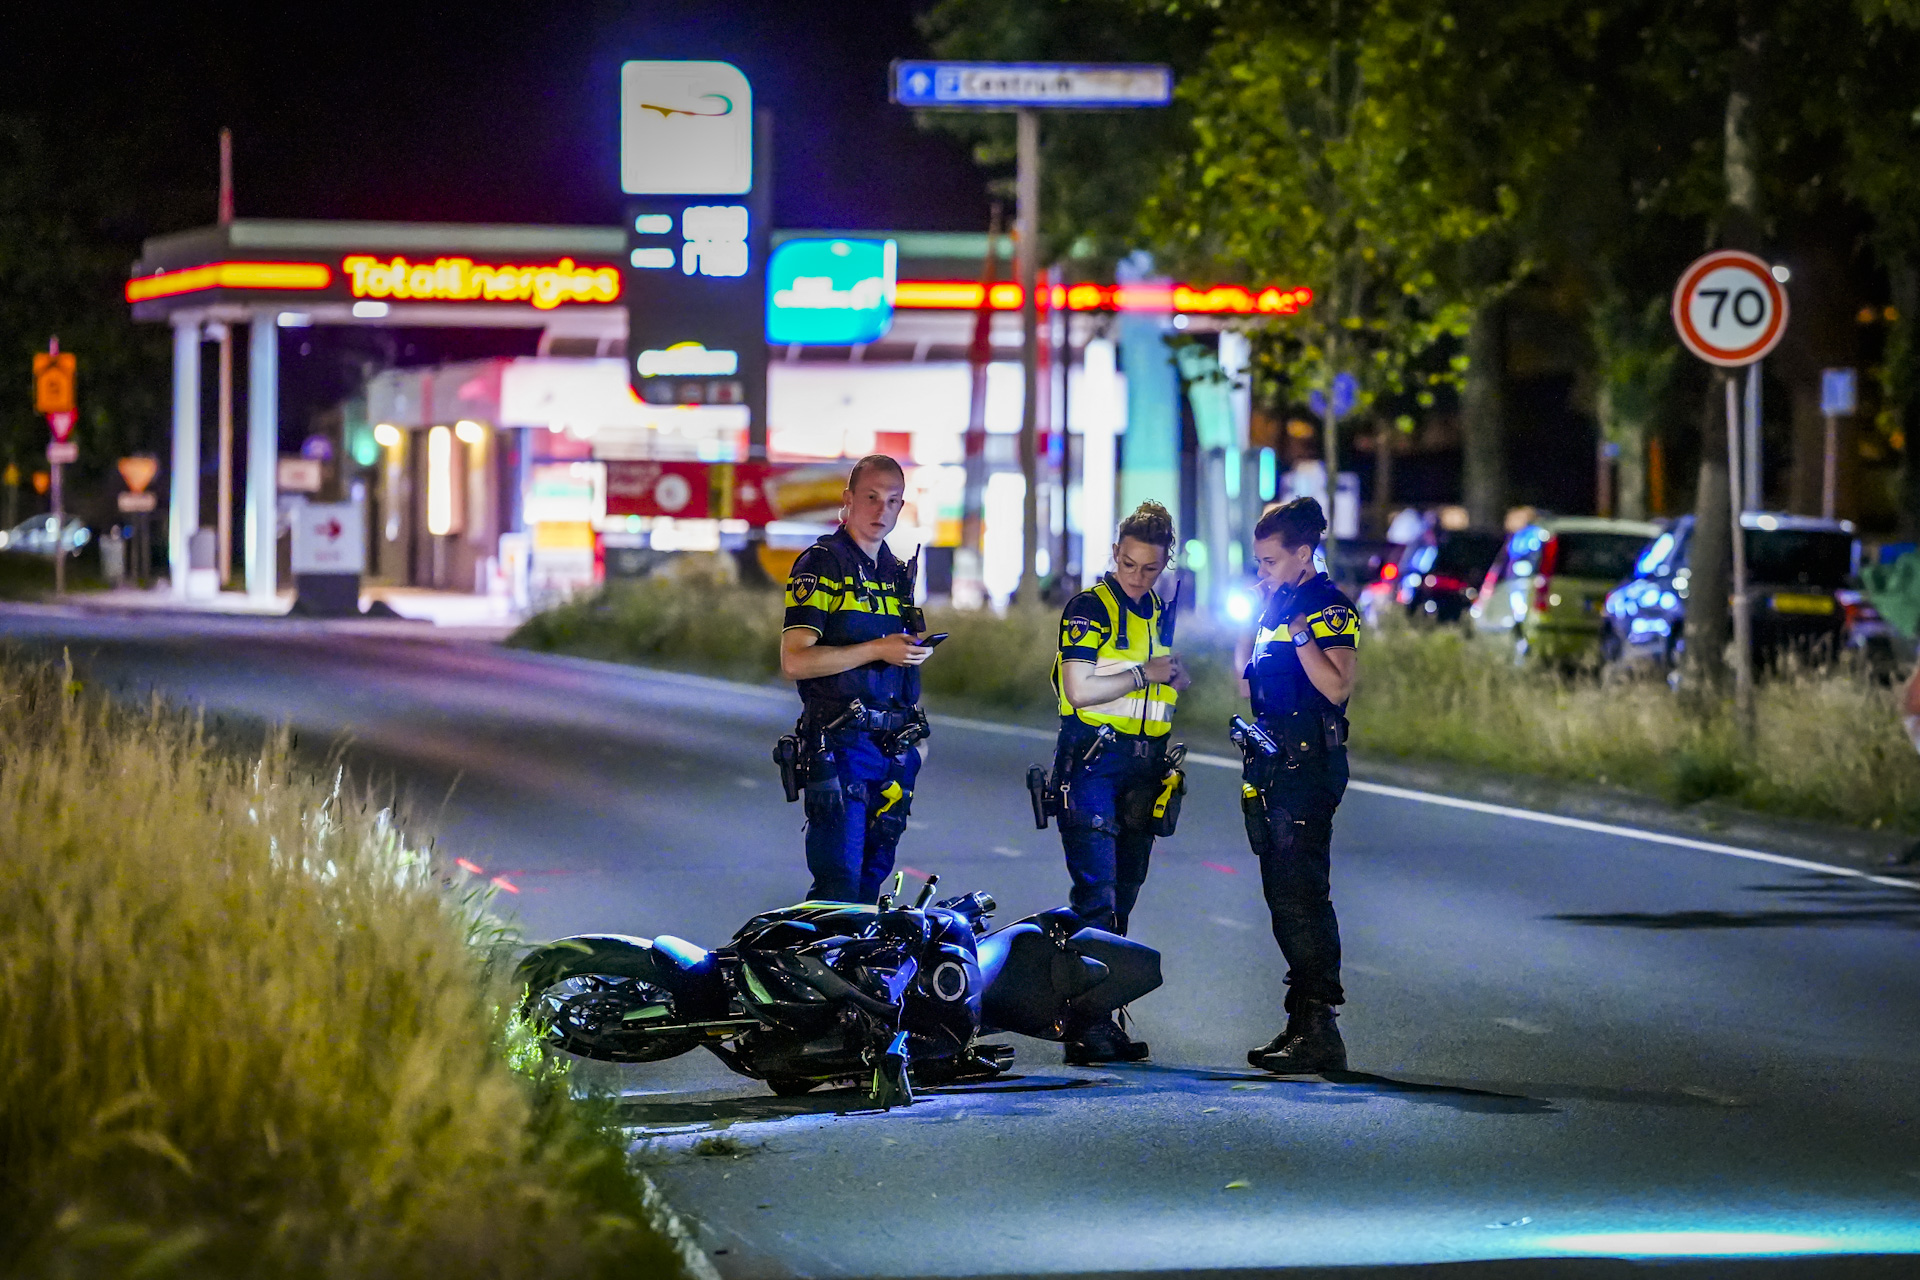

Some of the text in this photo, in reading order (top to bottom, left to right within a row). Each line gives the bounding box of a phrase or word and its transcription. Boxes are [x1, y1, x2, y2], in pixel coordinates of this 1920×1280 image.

[962, 69, 1073, 95] Centrum
[344, 255, 620, 309] TotalEnergies
[1699, 288, 1765, 329] 70
